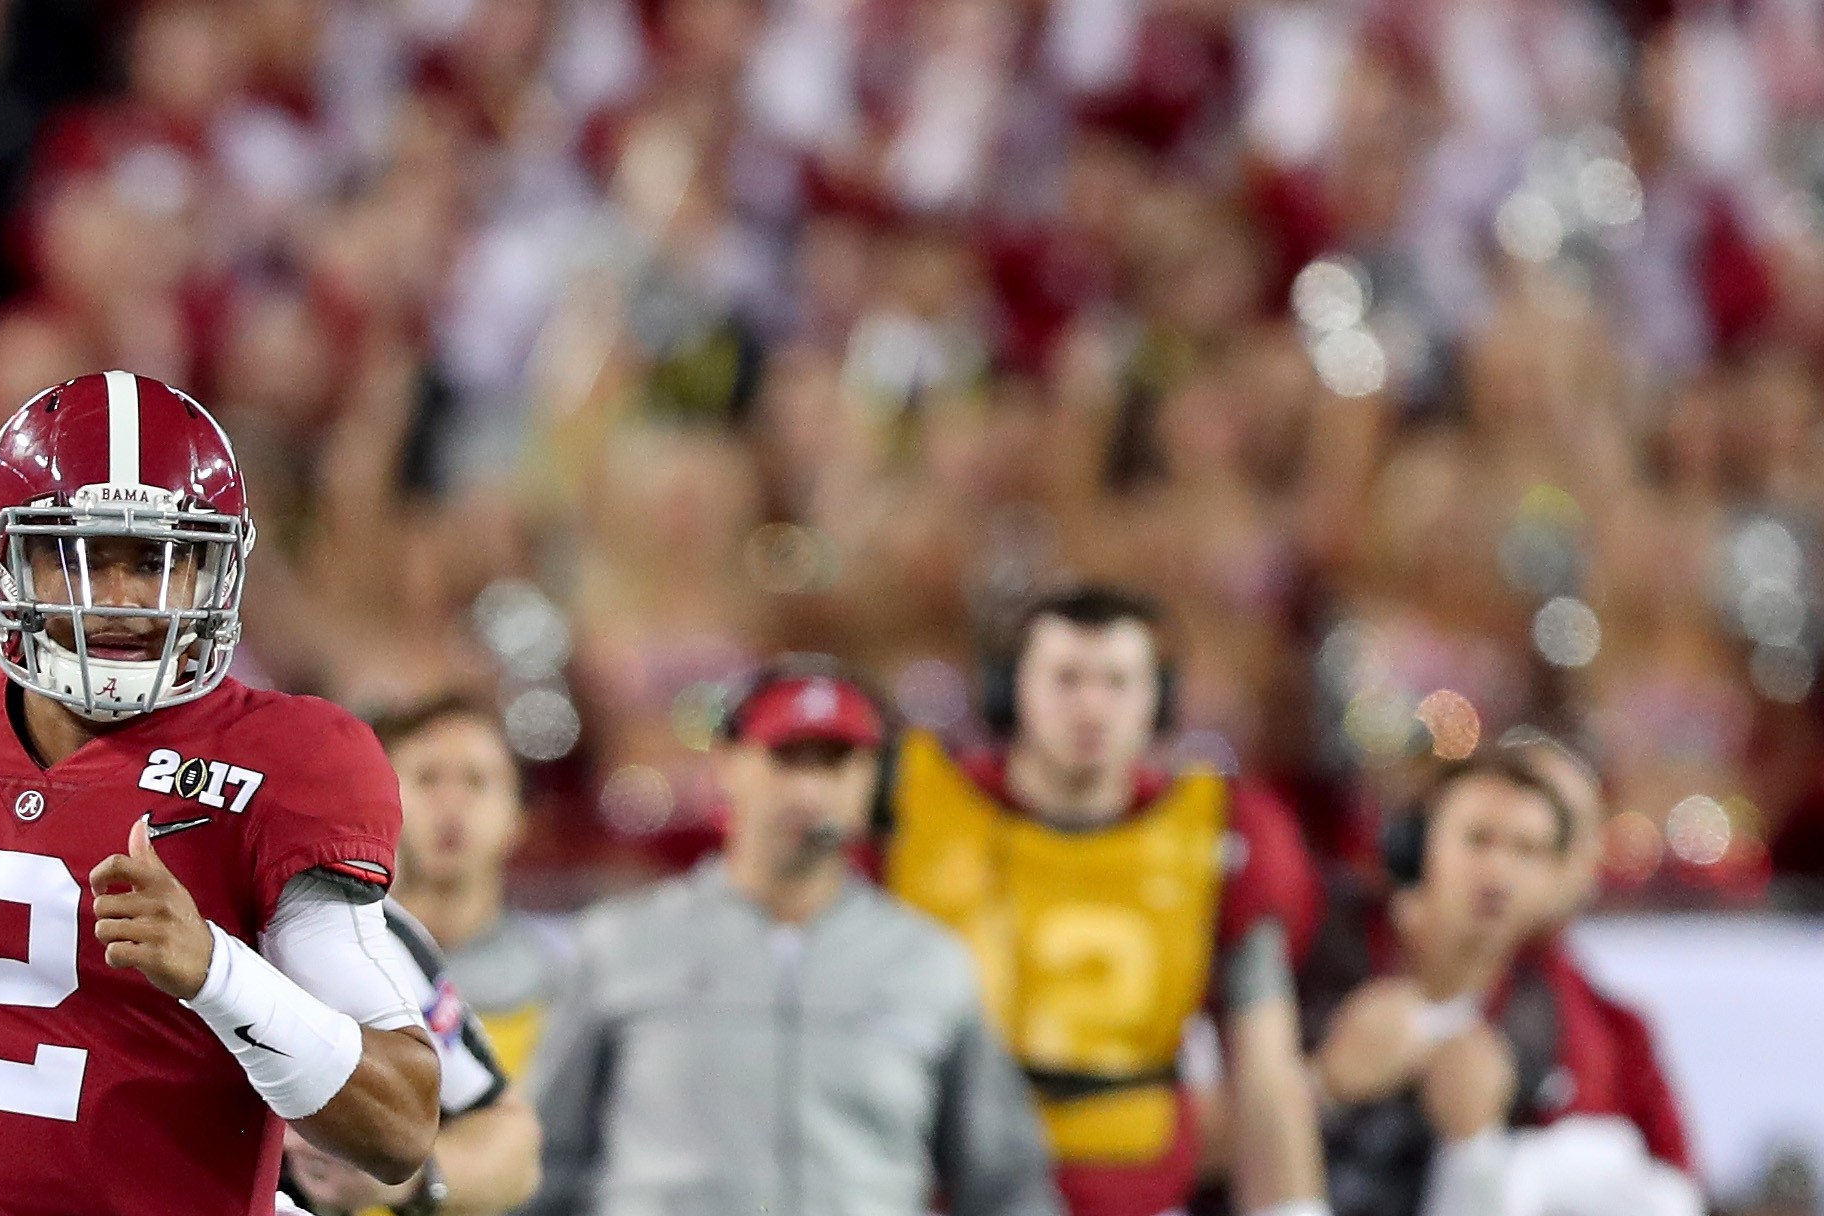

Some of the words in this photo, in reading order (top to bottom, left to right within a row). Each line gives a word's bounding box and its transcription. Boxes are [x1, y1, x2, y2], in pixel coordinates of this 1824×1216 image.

[102, 488, 149, 502] BAMA
[94, 677, 117, 699] A
[138, 748, 264, 814] 2017
[18, 793, 40, 815] A
[1025, 905, 1157, 1071] 2
